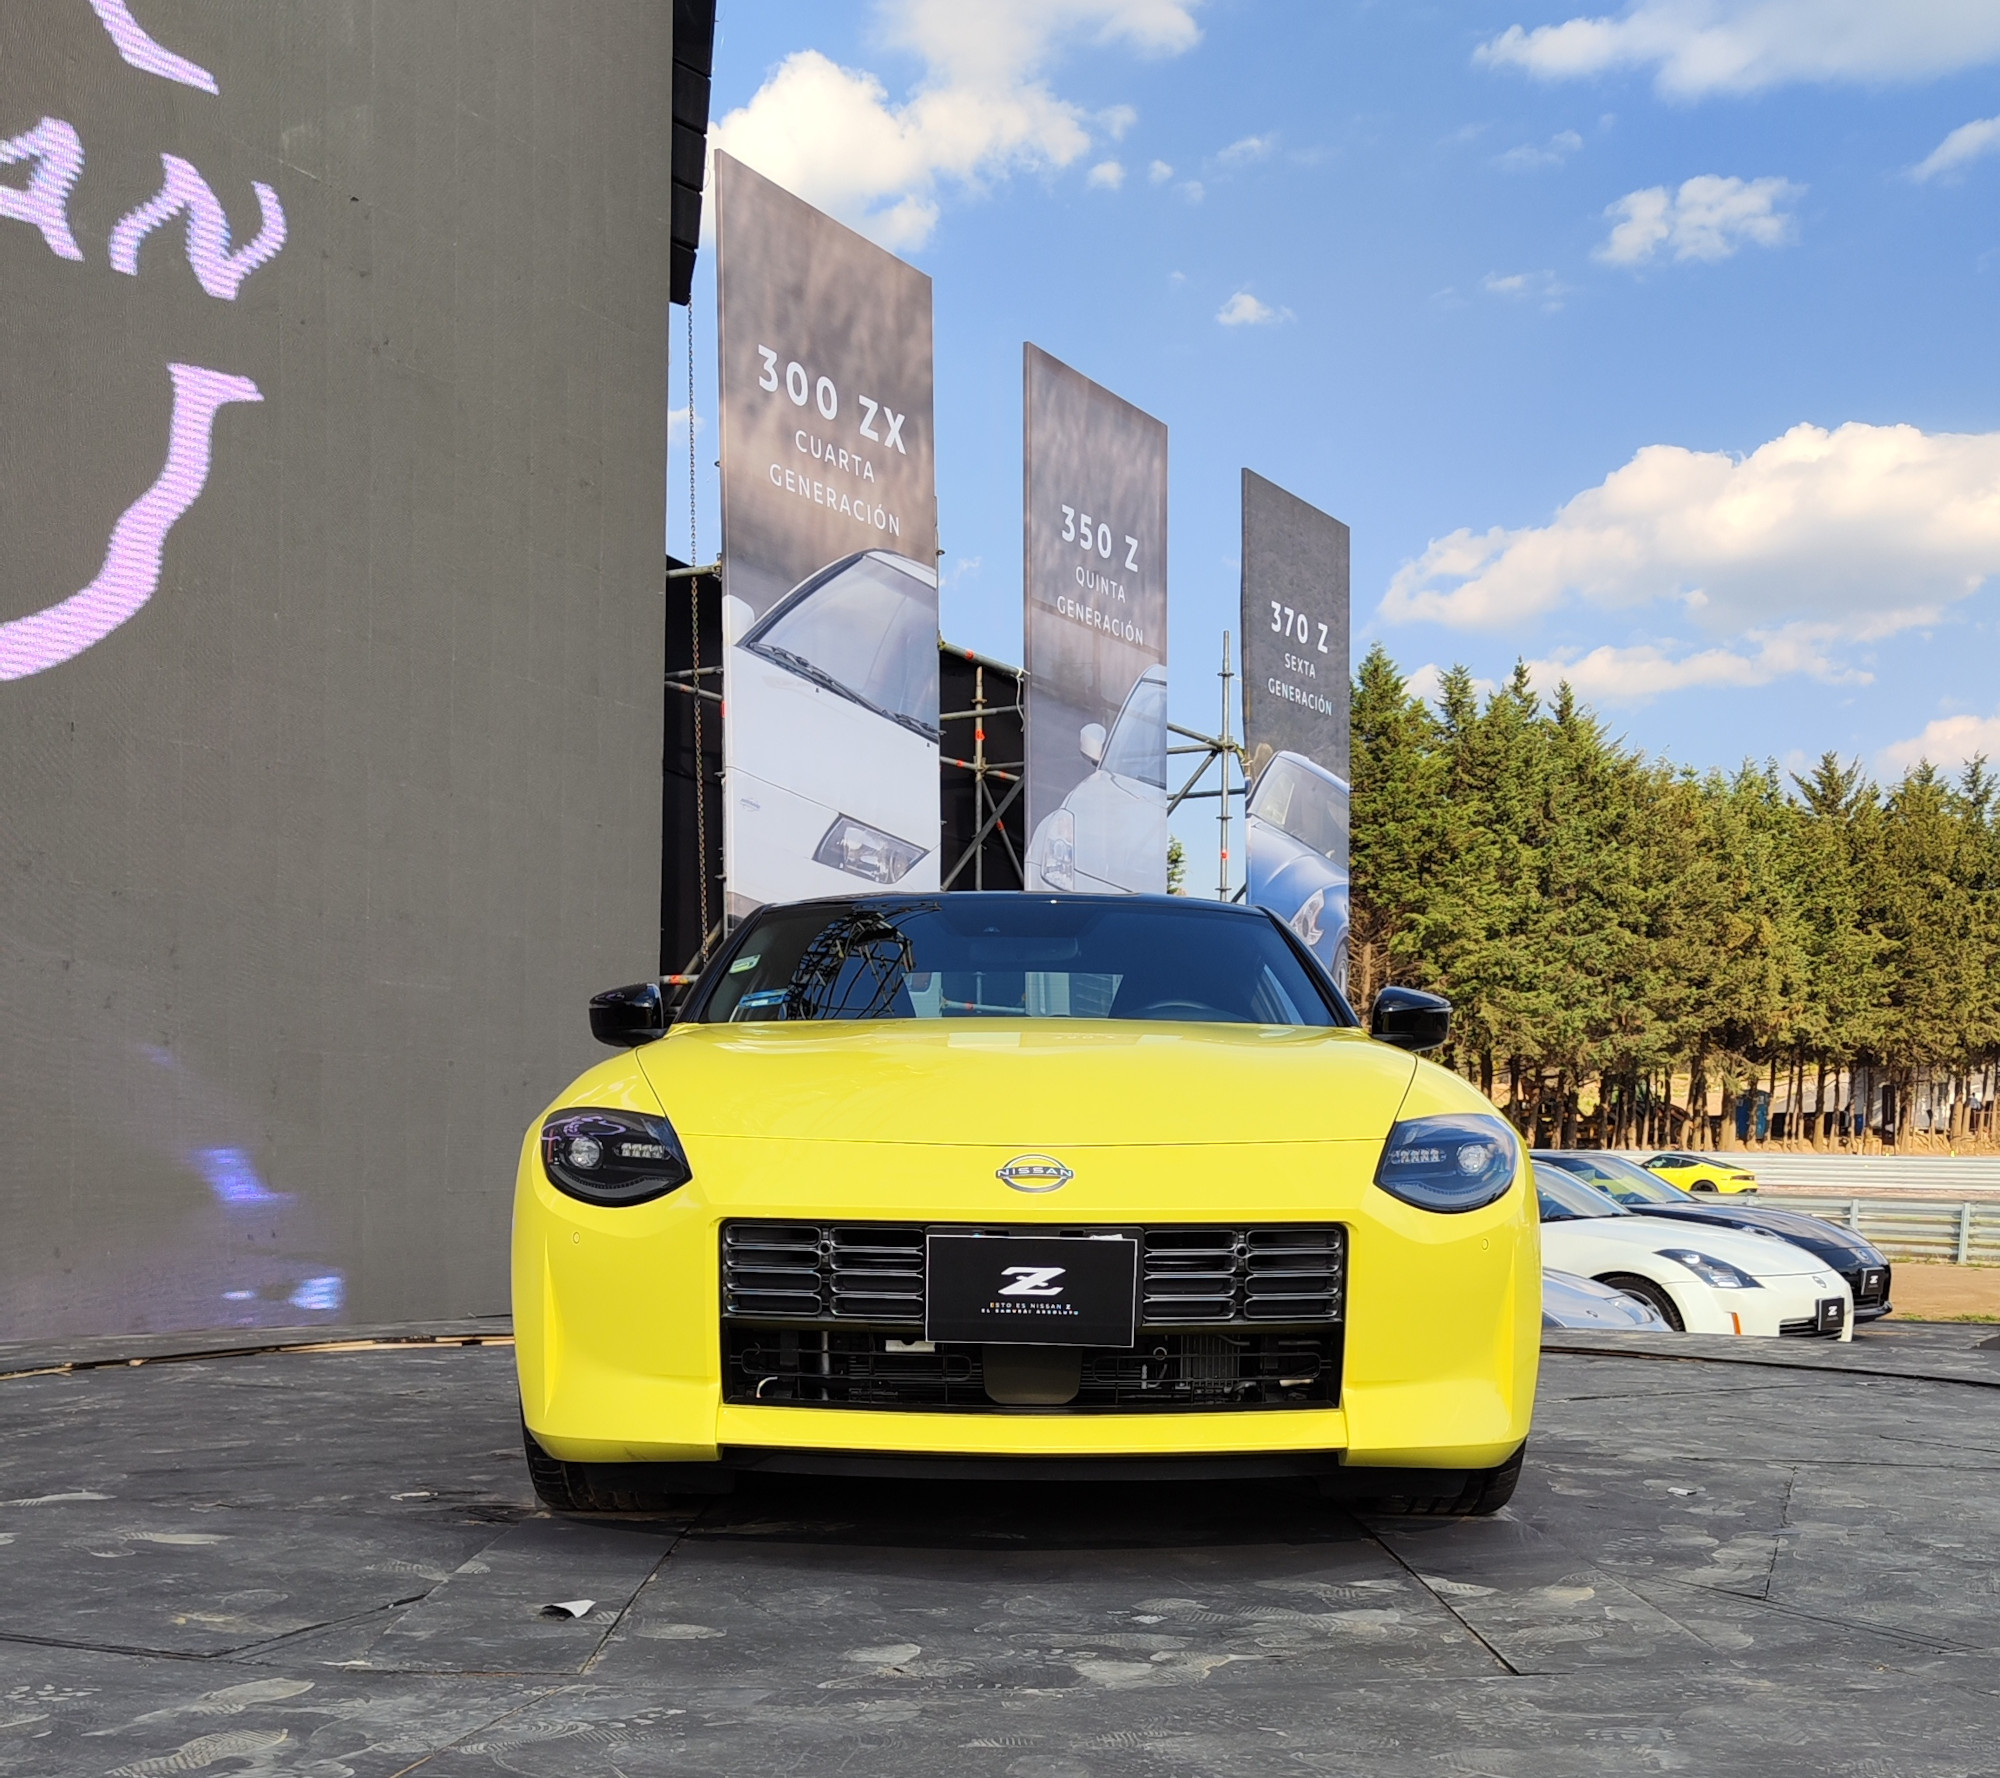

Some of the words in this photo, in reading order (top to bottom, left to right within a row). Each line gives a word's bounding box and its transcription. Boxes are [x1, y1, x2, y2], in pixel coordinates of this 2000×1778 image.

[757, 344, 838, 421] 300
[858, 394, 907, 455] ZX
[795, 430, 875, 483] CUARTA
[769, 463, 900, 537] GENERACIÓN
[1061, 504, 1112, 559] 350
[1124, 535, 1139, 573] Z
[1075, 566, 1126, 603] QUINTA
[1056, 595, 1144, 646] GENERACIÓN
[1270, 600, 1309, 644] 370
[1317, 622, 1329, 654] Z
[1284, 652, 1316, 679] SEXTA
[1267, 677, 1332, 716] GENERACIÓN
[997, 1166, 1072, 1177] NISSAN
[998, 1266, 1066, 1296] Z
